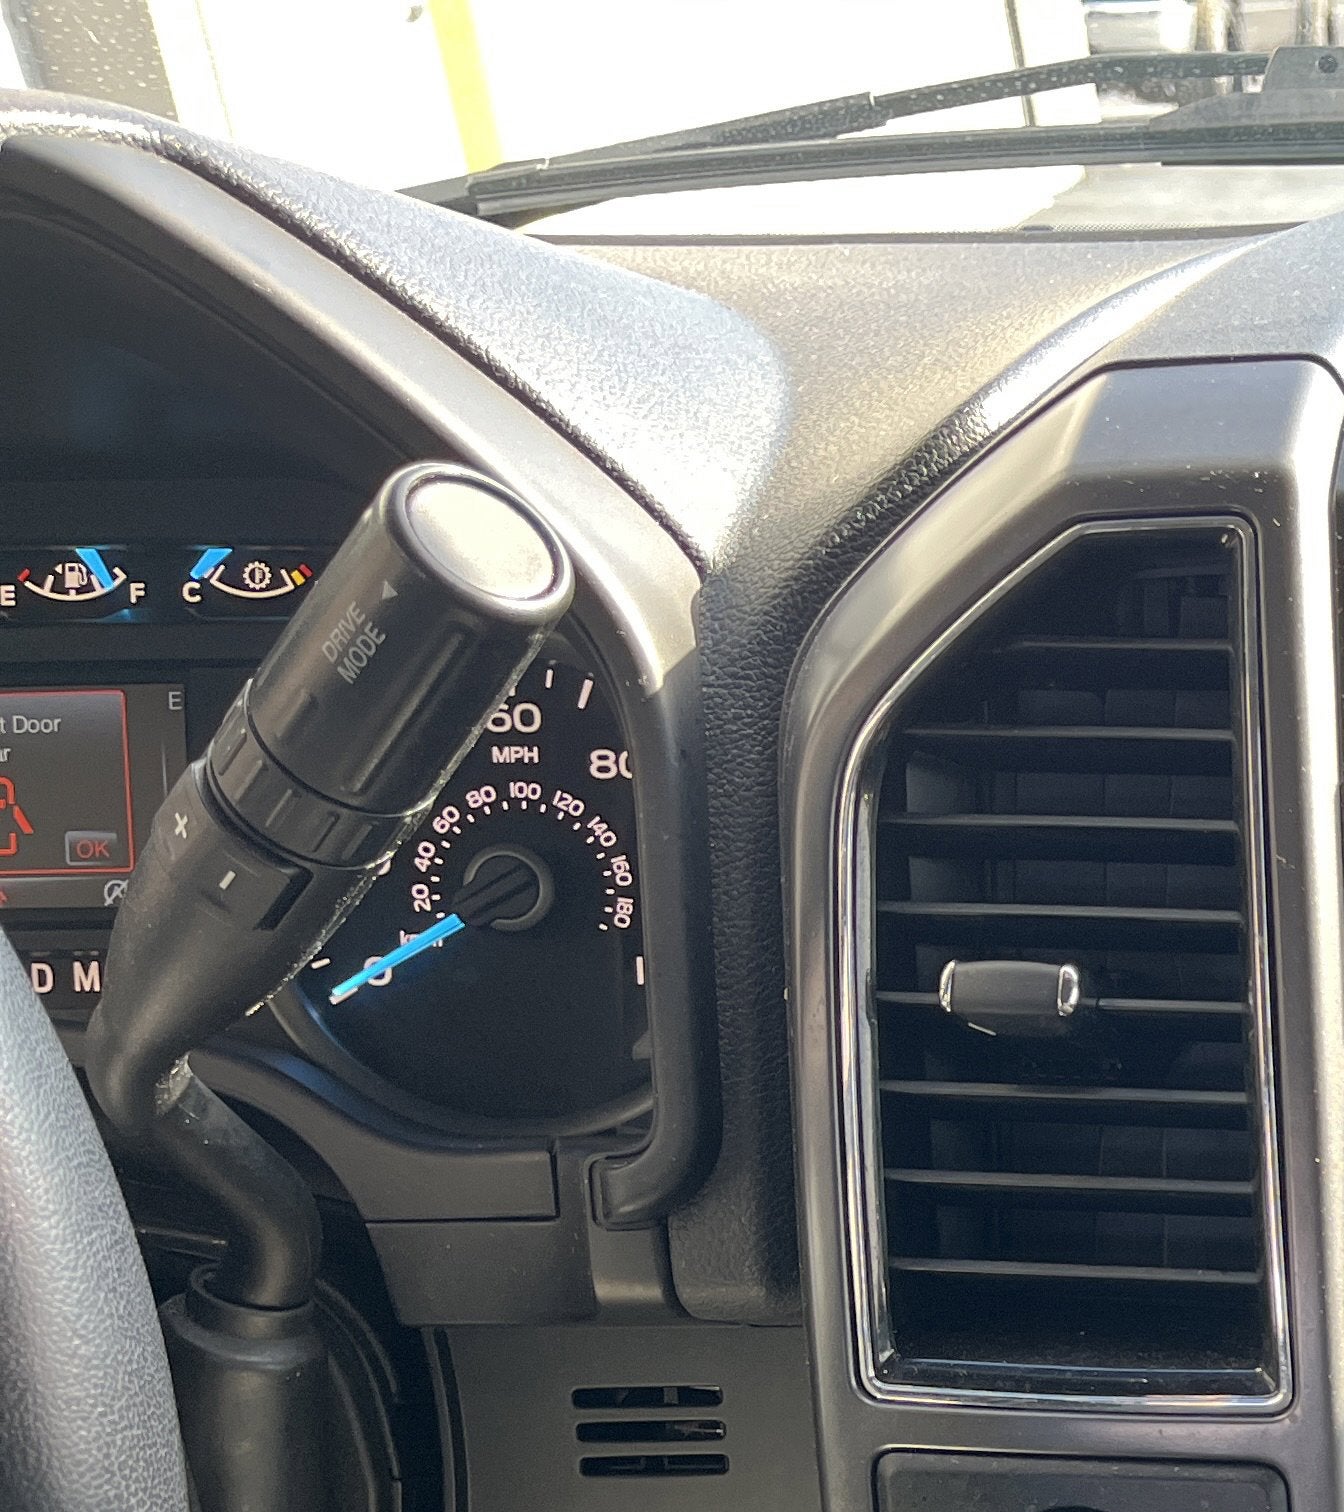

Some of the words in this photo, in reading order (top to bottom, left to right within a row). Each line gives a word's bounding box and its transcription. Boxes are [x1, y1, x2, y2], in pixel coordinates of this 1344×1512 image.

[130, 582, 146, 604] F
[182, 581, 202, 604] C
[321, 600, 366, 664] DRIVE
[337, 621, 386, 685] MODE
[168, 691, 183, 711] E
[12, 715, 62, 734] Door
[491, 745, 540, 764] MPH
[465, 785, 497, 809] 80
[508, 781, 542, 800] 100
[552, 789, 585, 817] 120
[432, 805, 461, 835] 60
[586, 815, 617, 848] 140
[76, 839, 110, 860] OK
[413, 840, 436, 873] 40
[610, 854, 633, 887] 160
[411, 883, 432, 913] 20
[613, 896, 634, 929] 180
[31, 962, 54, 994] D
[73, 961, 101, 993] M
